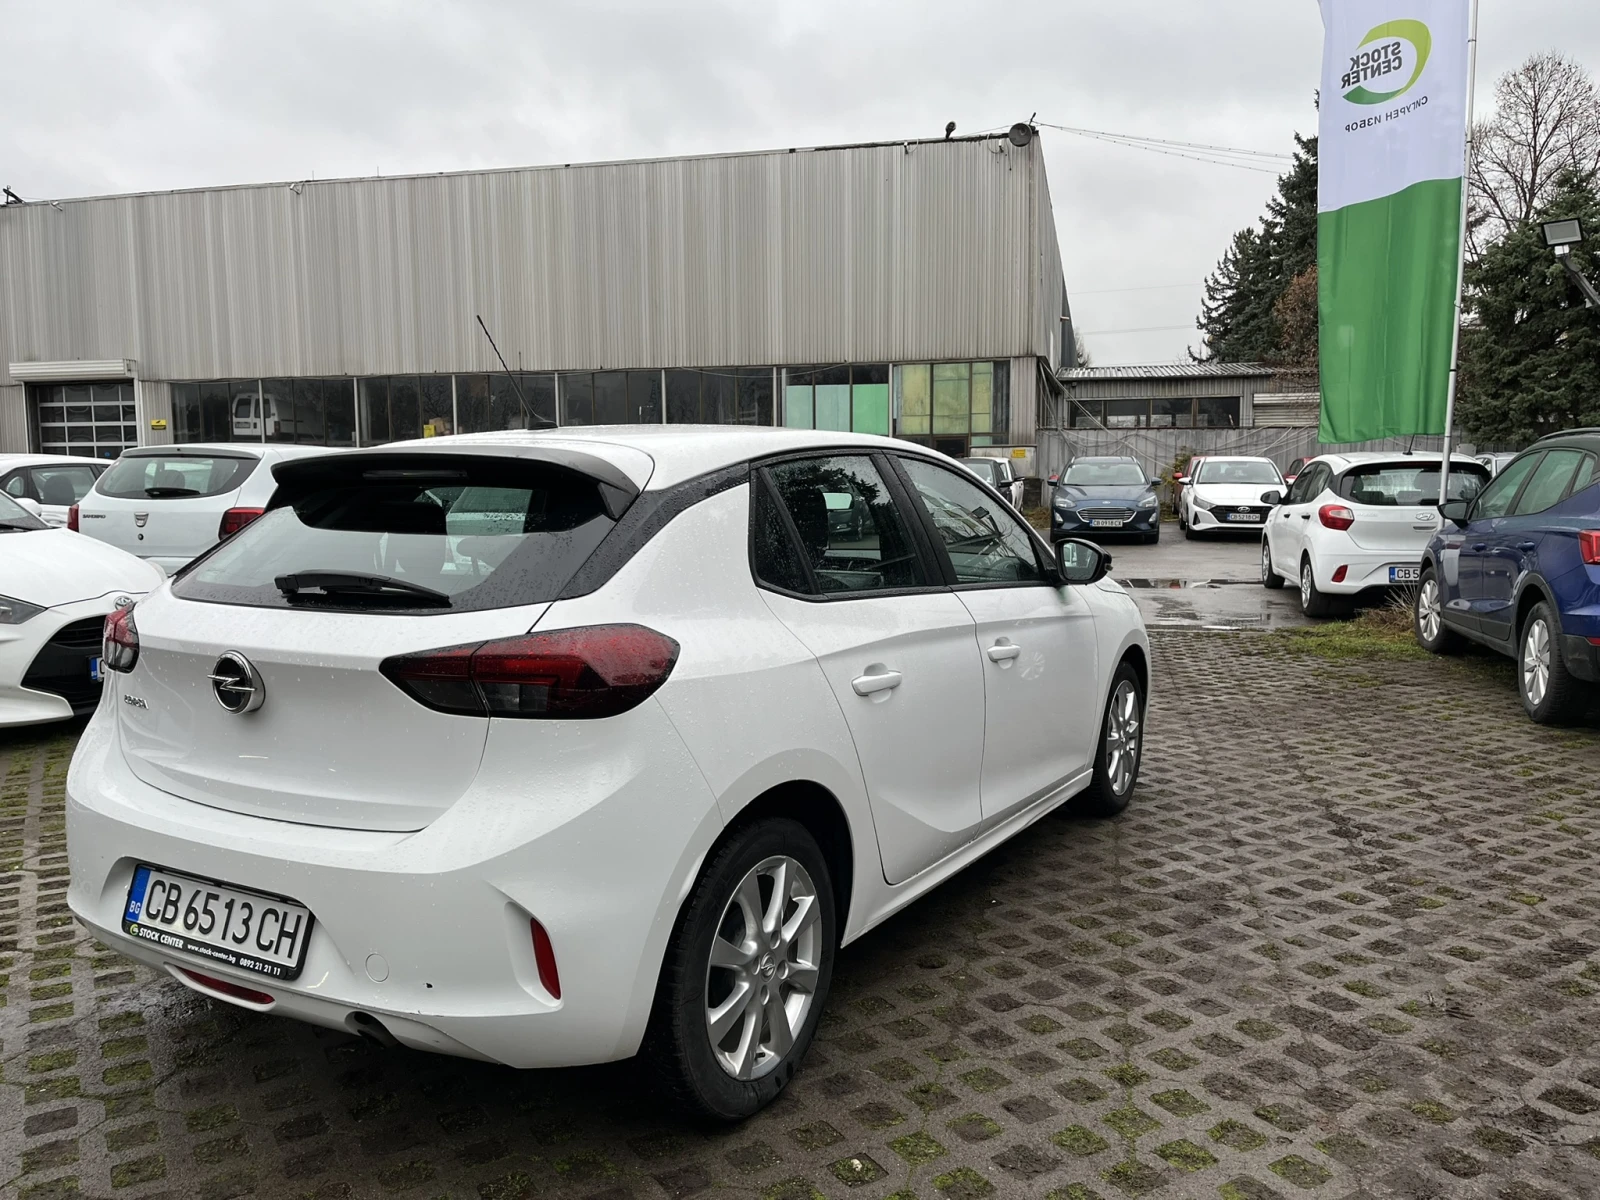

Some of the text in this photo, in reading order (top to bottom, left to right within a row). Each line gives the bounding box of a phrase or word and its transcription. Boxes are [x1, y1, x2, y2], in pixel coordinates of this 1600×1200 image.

[129, 900, 141, 914] BG
[139, 928, 281, 976] STOCK CENTER www.stock-center.bg 0892 21 21 11
